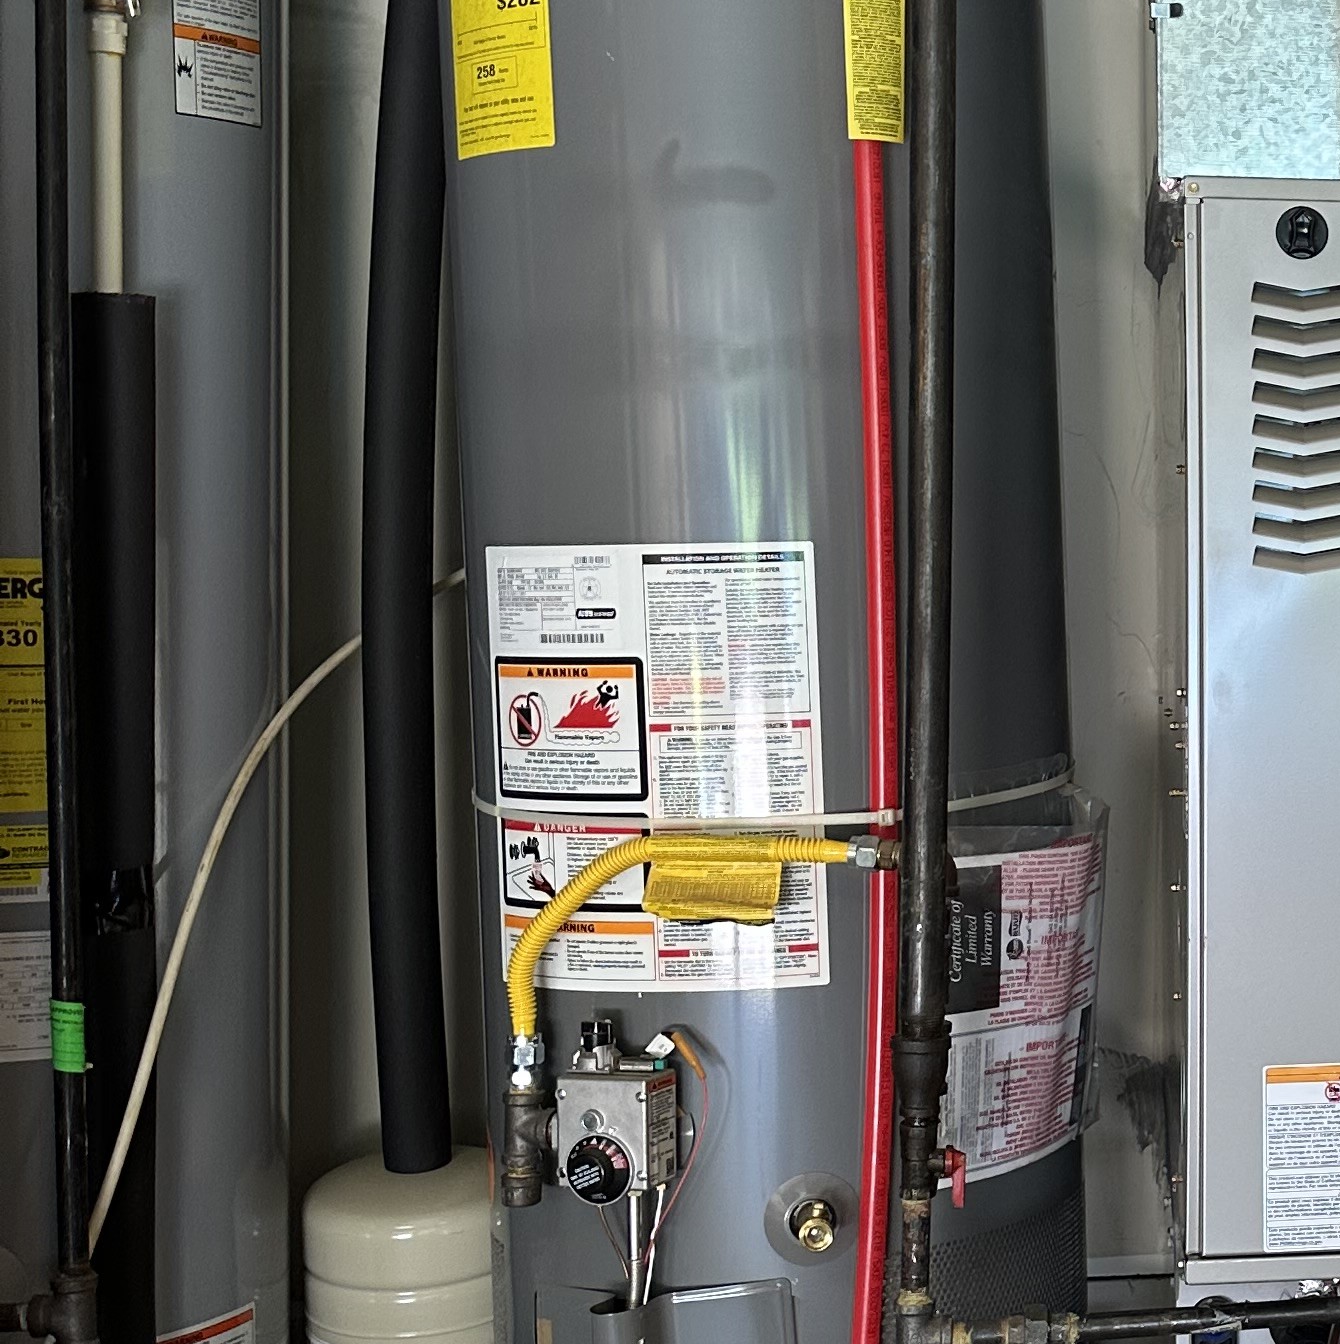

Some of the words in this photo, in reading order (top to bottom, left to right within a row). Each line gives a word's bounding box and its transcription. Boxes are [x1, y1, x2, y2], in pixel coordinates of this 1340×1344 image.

[476, 64, 496, 79] 258
[0, 578, 43, 599] ERG
[536, 668, 589, 678] WARNING
[541, 824, 586, 833] DANGER
[950, 900, 965, 914] of
[559, 922, 596, 933] ARNING
[964, 914, 978, 964] Limited
[980, 908, 997, 967] Warranty
[949, 917, 965, 983] Certificate
